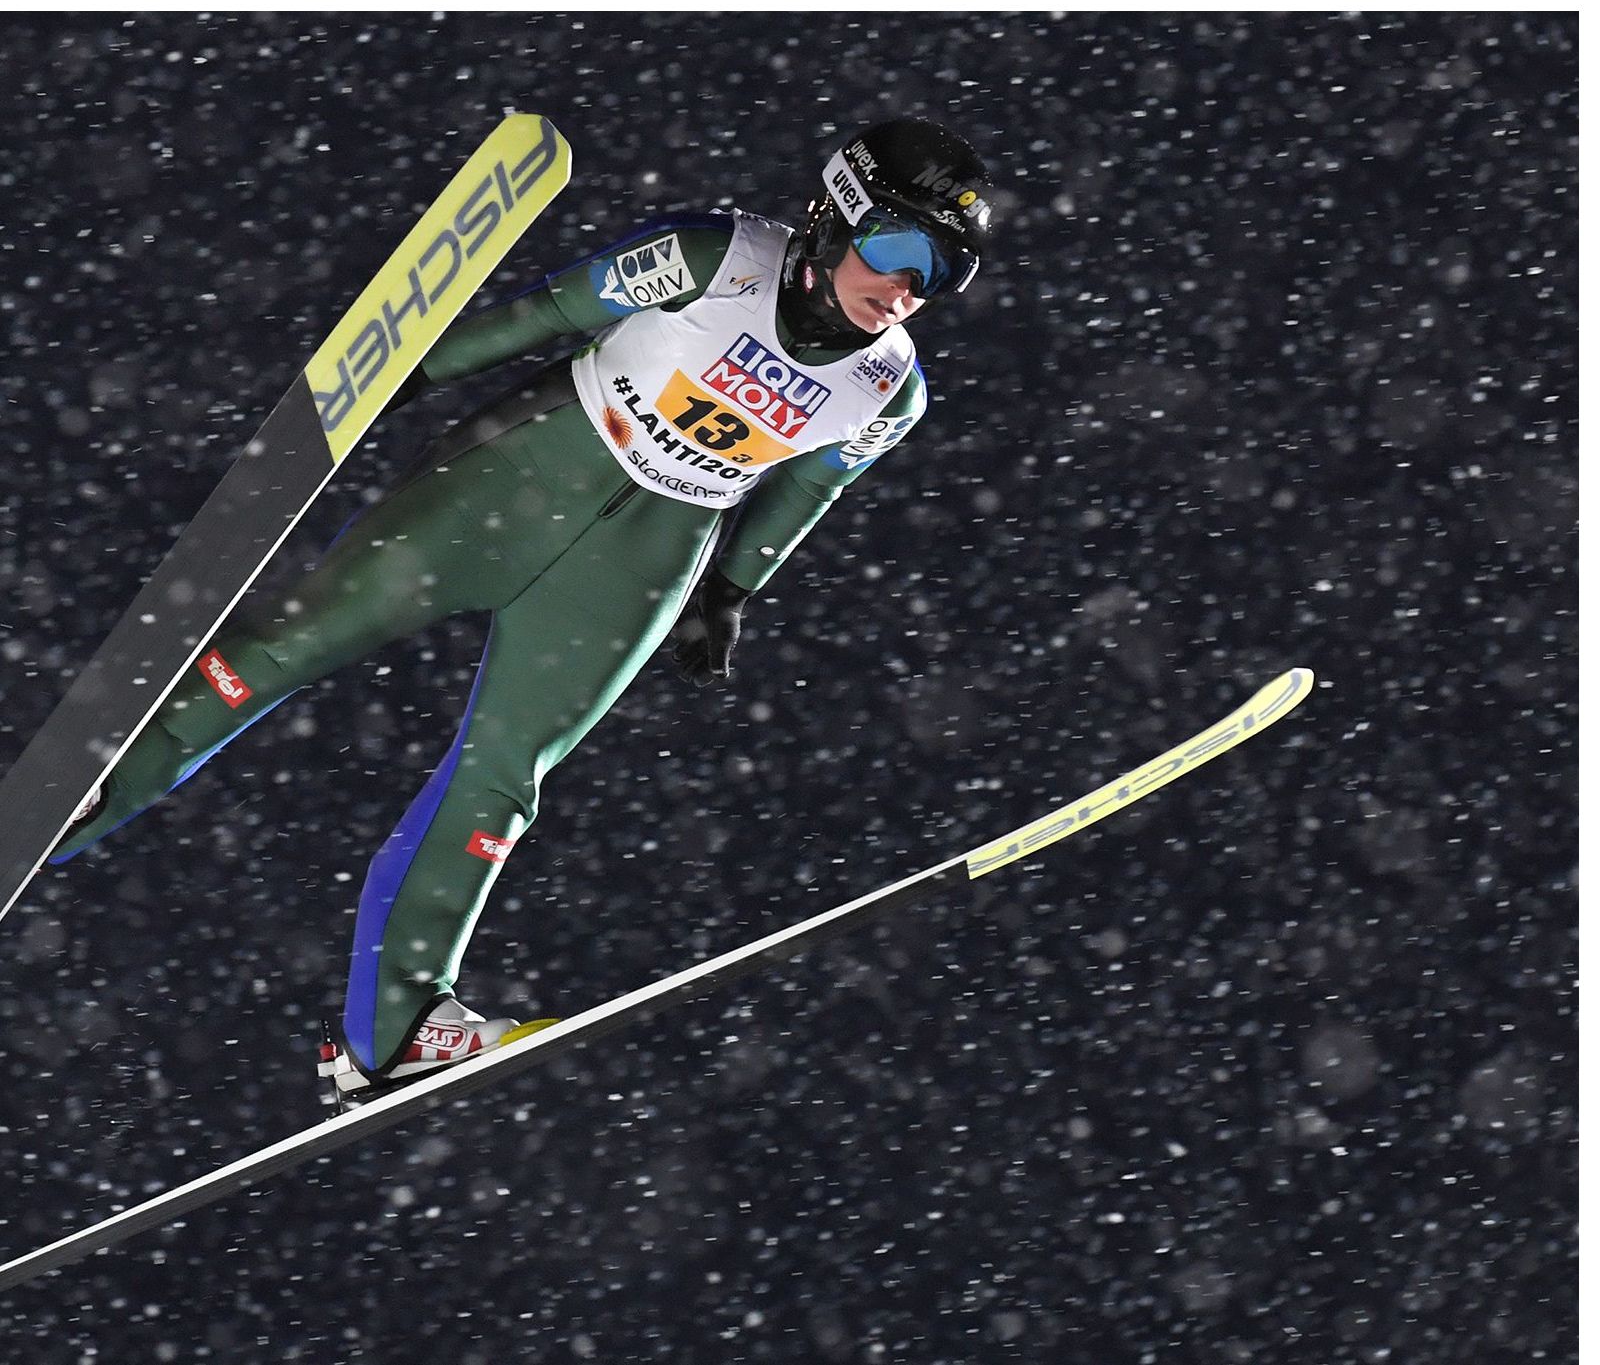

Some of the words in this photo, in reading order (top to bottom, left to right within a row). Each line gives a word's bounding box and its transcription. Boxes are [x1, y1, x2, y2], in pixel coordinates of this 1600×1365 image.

[850, 140, 878, 176] uvex
[832, 168, 865, 215] uvex
[313, 116, 558, 433] FISCHER
[633, 269, 683, 304] OMV
[727, 337, 829, 414] LIQUI
[857, 362, 880, 384] 2017
[864, 351, 898, 383] LAHTI
[672, 395, 749, 450] 13
[705, 361, 808, 437] MOLY
[968, 671, 1303, 872] FISCHER
